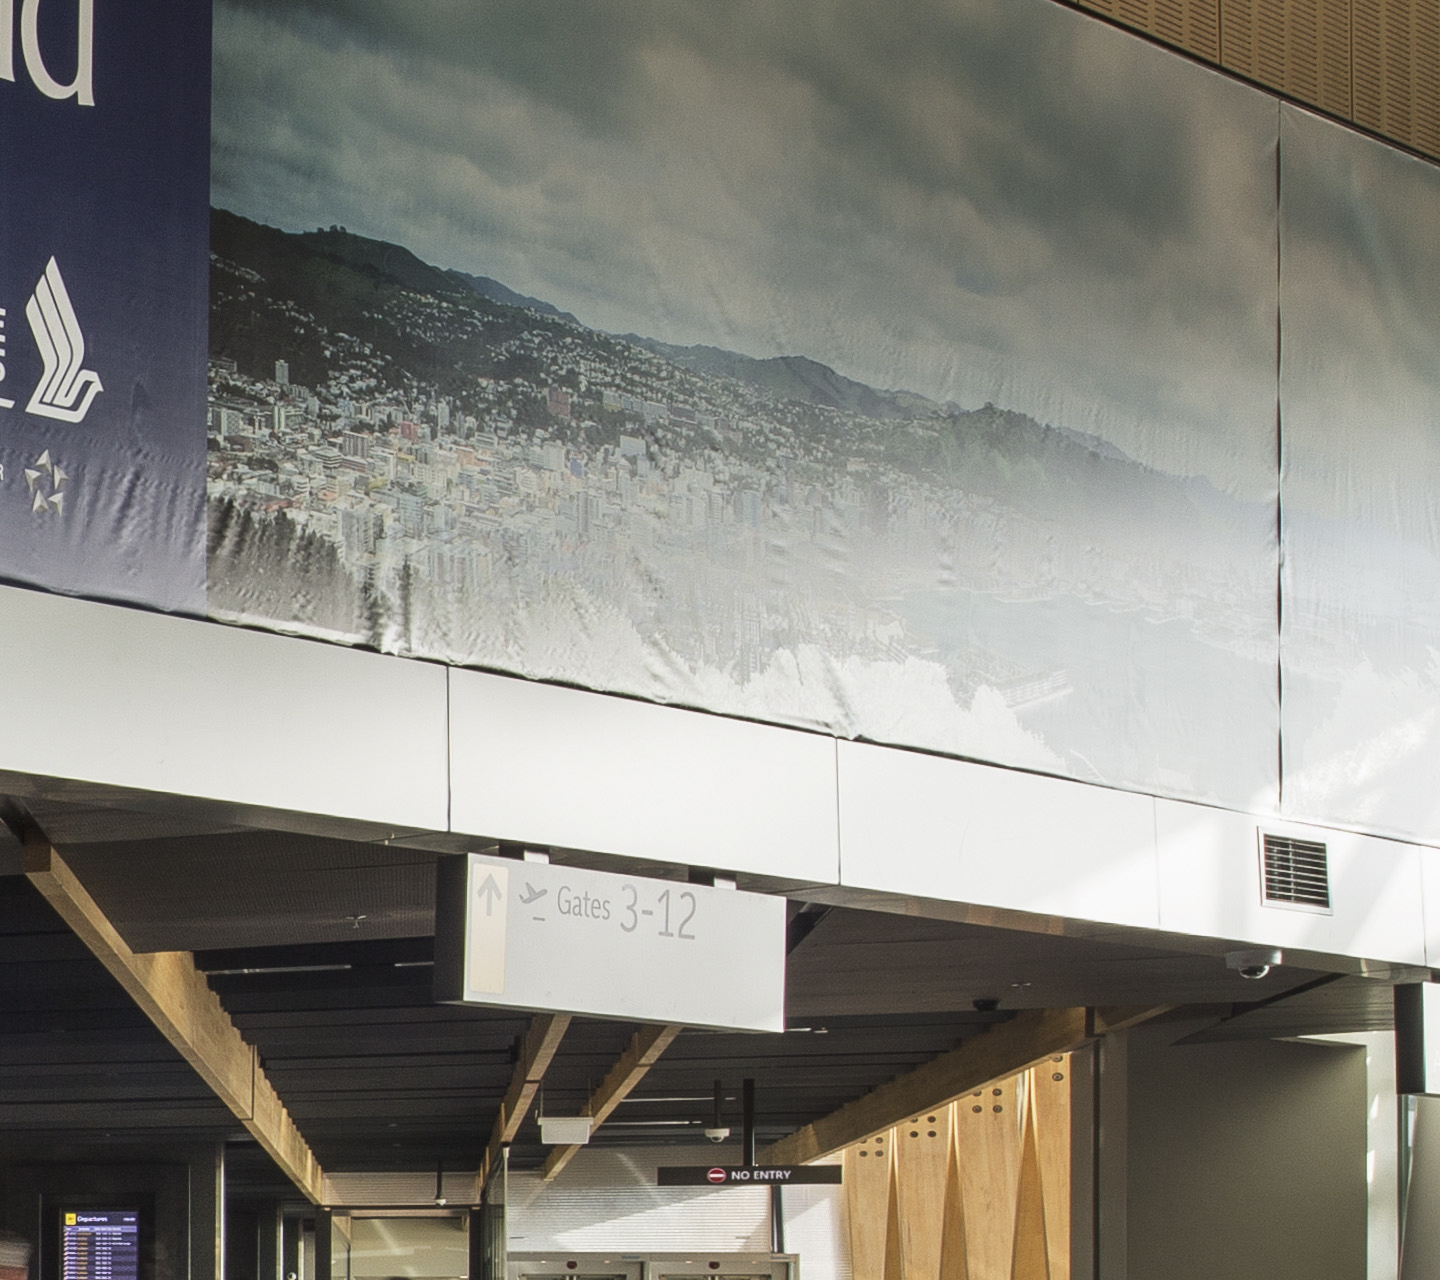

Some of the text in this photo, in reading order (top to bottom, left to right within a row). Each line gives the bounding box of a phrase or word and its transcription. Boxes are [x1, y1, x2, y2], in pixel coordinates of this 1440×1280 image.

[556, 883, 697, 940] Gates 3-12
[730, 1170, 792, 1180] NO ENTRY
